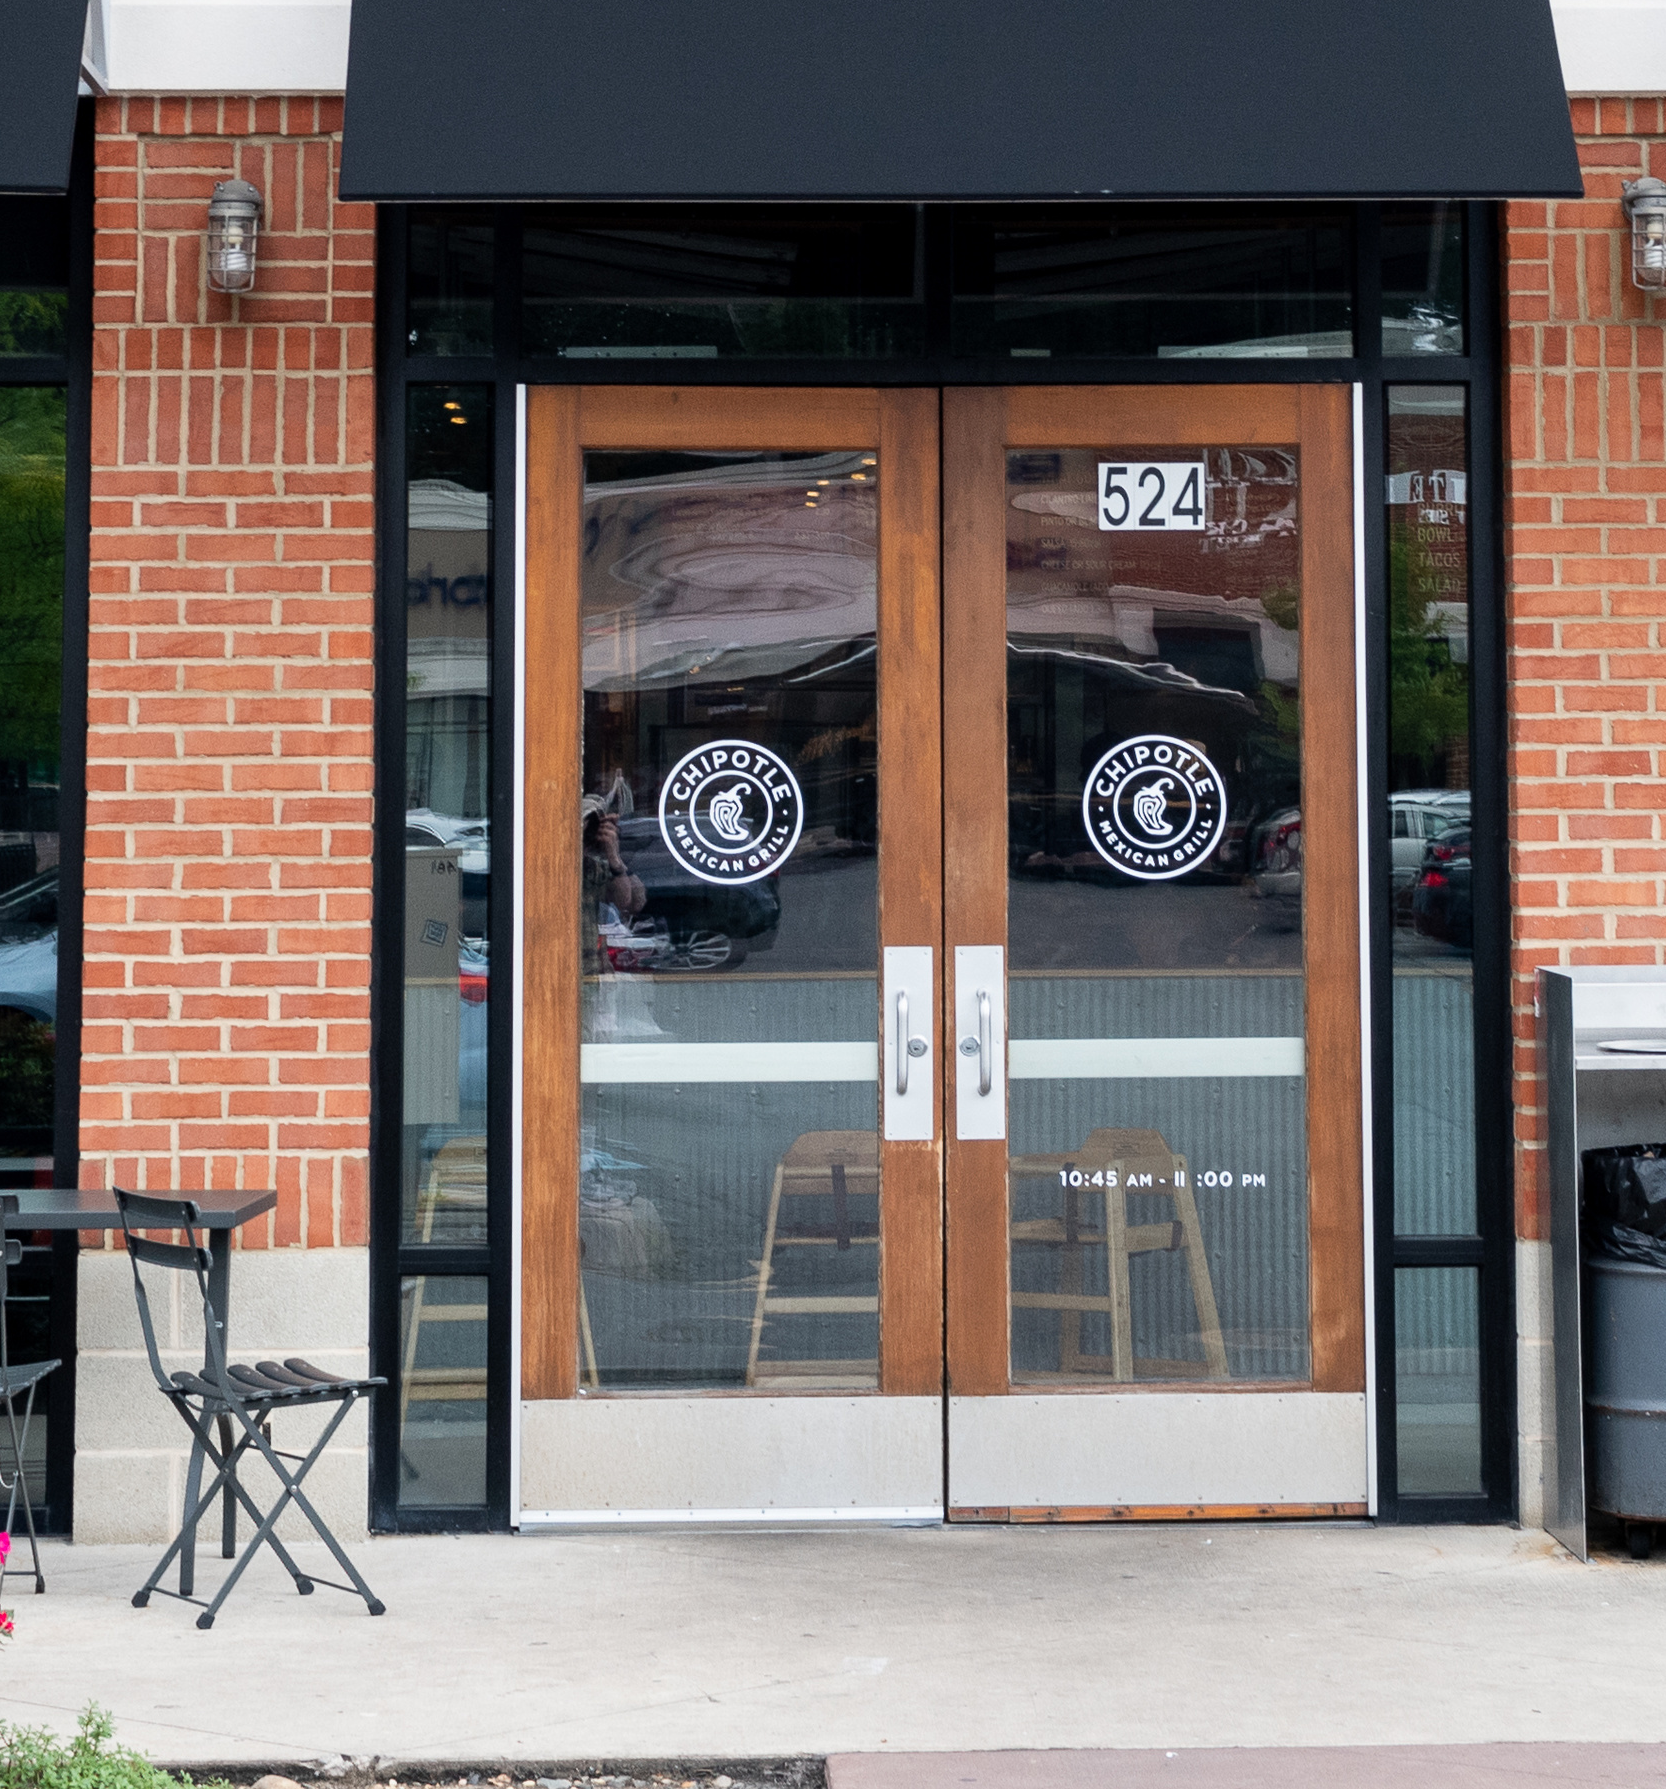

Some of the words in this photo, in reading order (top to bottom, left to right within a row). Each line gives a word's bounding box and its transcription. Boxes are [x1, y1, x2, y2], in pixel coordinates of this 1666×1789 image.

[1102, 466, 1203, 527] 524
[1419, 552, 1461, 568] TACOS
[672, 750, 792, 802] CHIPOTLE
[1096, 745, 1214, 797] CHIPOTLE
[674, 824, 744, 872] MEXICAN
[748, 825, 789, 867] GRILL
[1099, 820, 1169, 867] MEXICAN
[1173, 819, 1213, 862] GRILL
[1059, 1171, 1118, 1187] 10:45
[1127, 1174, 1152, 1187] AM
[1242, 1174, 1265, 1187] PM
